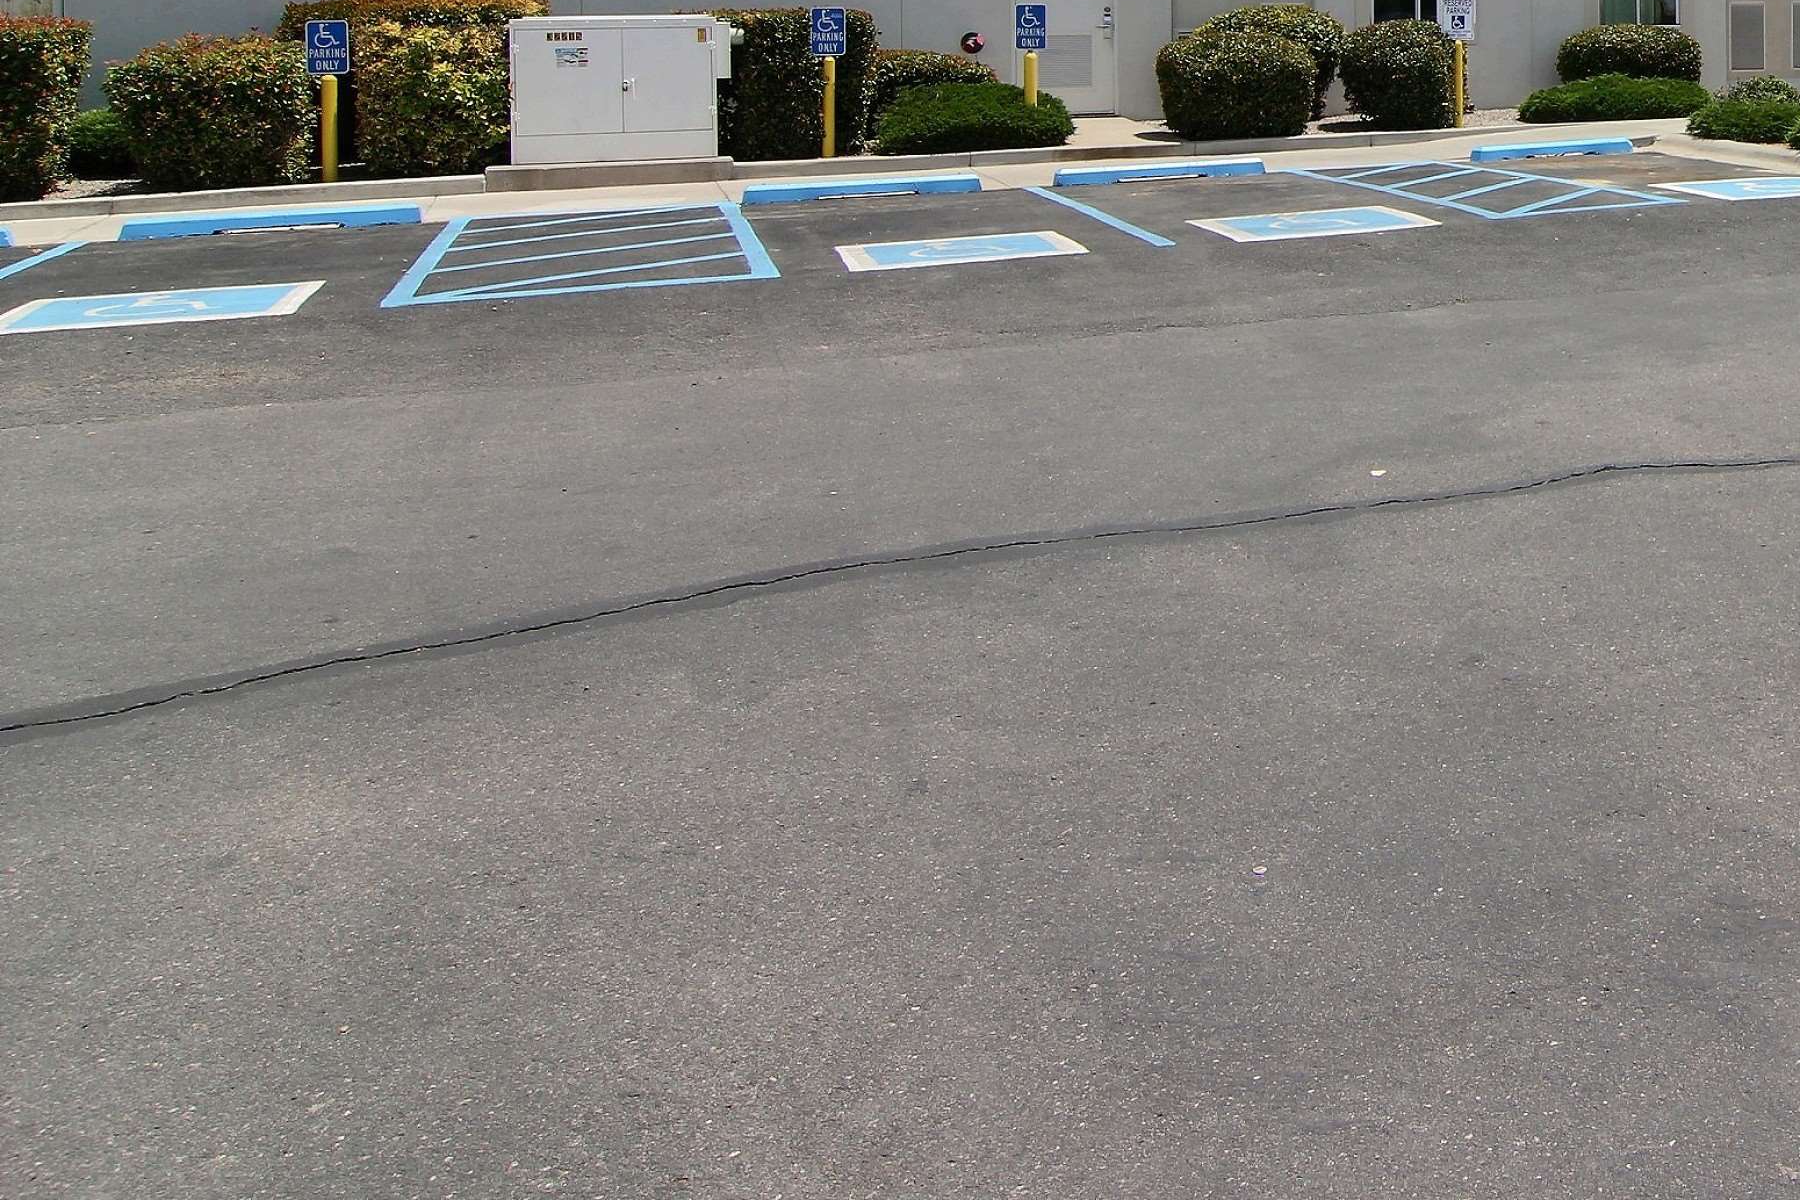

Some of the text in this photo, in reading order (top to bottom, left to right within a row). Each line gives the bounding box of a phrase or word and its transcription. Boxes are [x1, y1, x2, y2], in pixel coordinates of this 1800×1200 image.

[1446, 7, 1470, 15] PARKING
[812, 32, 844, 42] PARKING
[1016, 28, 1045, 37] PARKING
[818, 43, 838, 53] ONLY
[1021, 38, 1040, 48] ONLY
[309, 48, 346, 59] PARKING
[315, 60, 340, 70] ONLY
